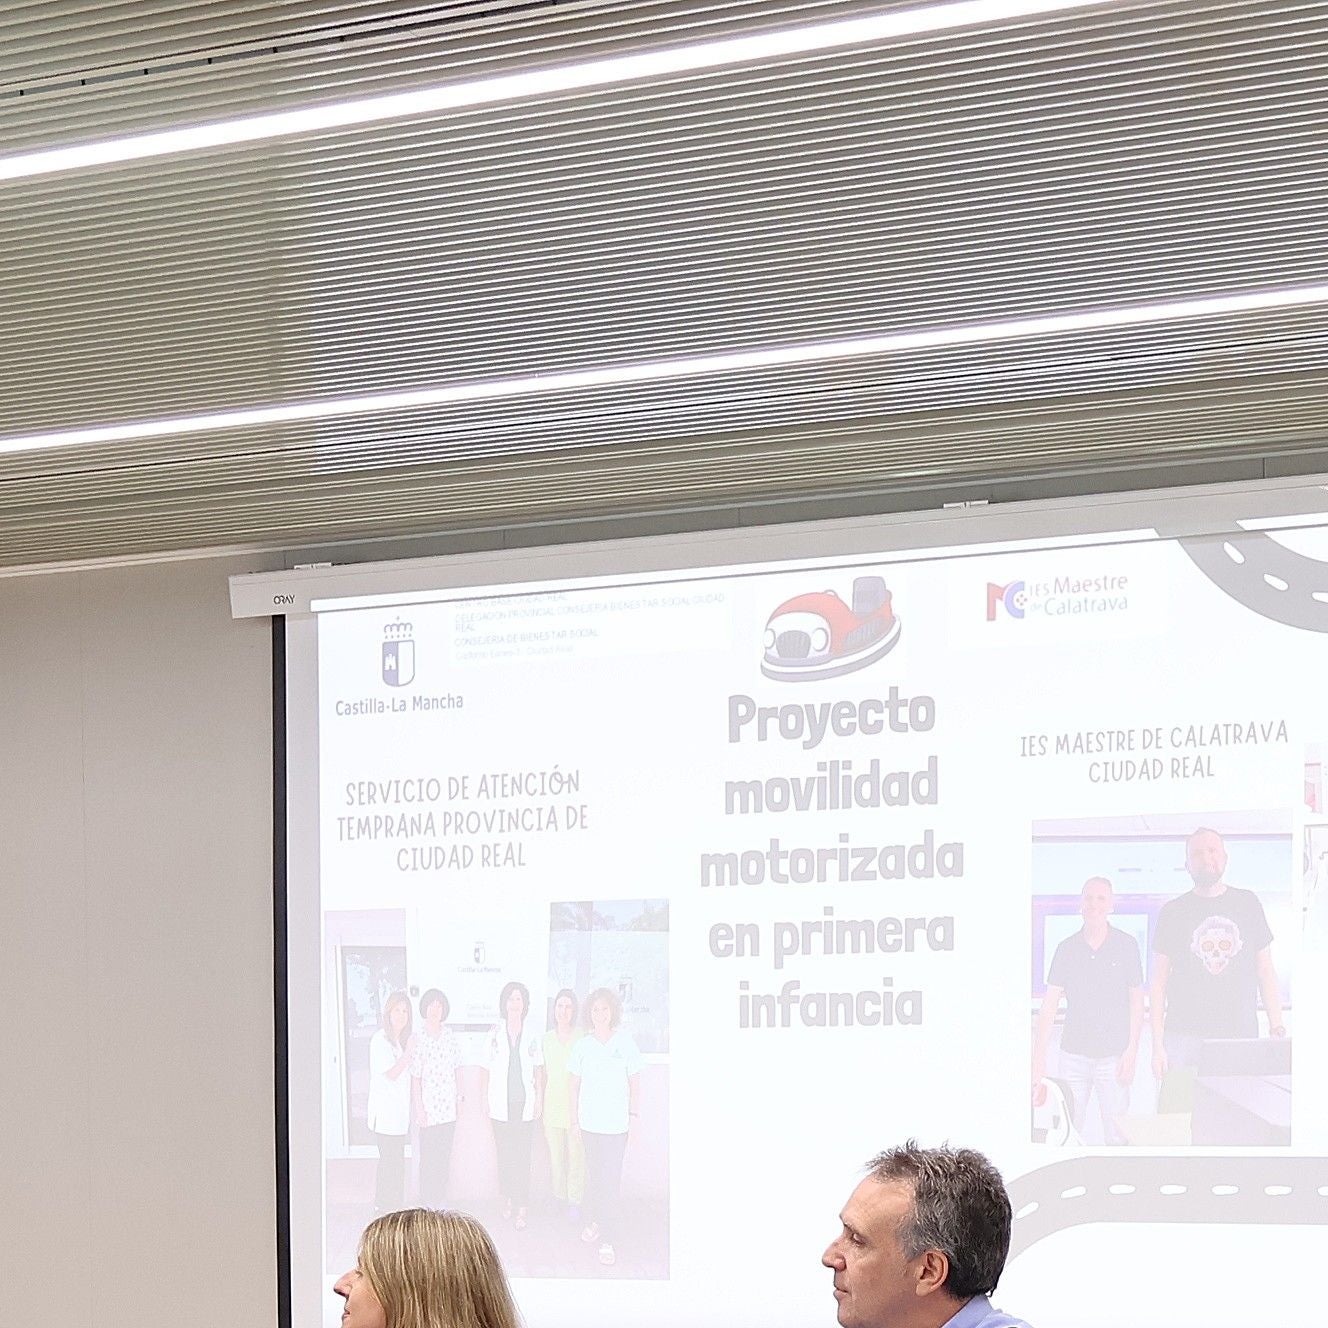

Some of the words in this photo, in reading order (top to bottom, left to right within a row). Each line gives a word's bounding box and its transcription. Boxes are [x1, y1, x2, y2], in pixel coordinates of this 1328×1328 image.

[1054, 575, 1128, 594] Maestre
[1044, 596, 1128, 616] Calatrava
[412, 693, 464, 712] Mancha
[728, 686, 936, 750] Proyecto
[1020, 735, 1048, 757] IES
[1055, 729, 1136, 755] MAESTRE
[1142, 728, 1163, 750] DE
[1170, 719, 1289, 748] CALATRAVA
[345, 777, 441, 806] SERVICIO
[448, 775, 470, 801] DE
[477, 764, 580, 800] ATENCIÓN
[725, 755, 939, 815] movilidad
[1088, 758, 1163, 784] CIUDAD
[1170, 755, 1215, 779] REAL
[337, 811, 436, 842] TEMPRANA
[443, 805, 559, 837] PROVINCIA
[566, 804, 589, 830] DE
[397, 844, 474, 872] CIUDAD
[481, 842, 526, 868] REAL
[700, 829, 965, 887] motorizada
[708, 922, 760, 958] en
[774, 906, 955, 970] primera
[739, 976, 923, 1028] infancia
